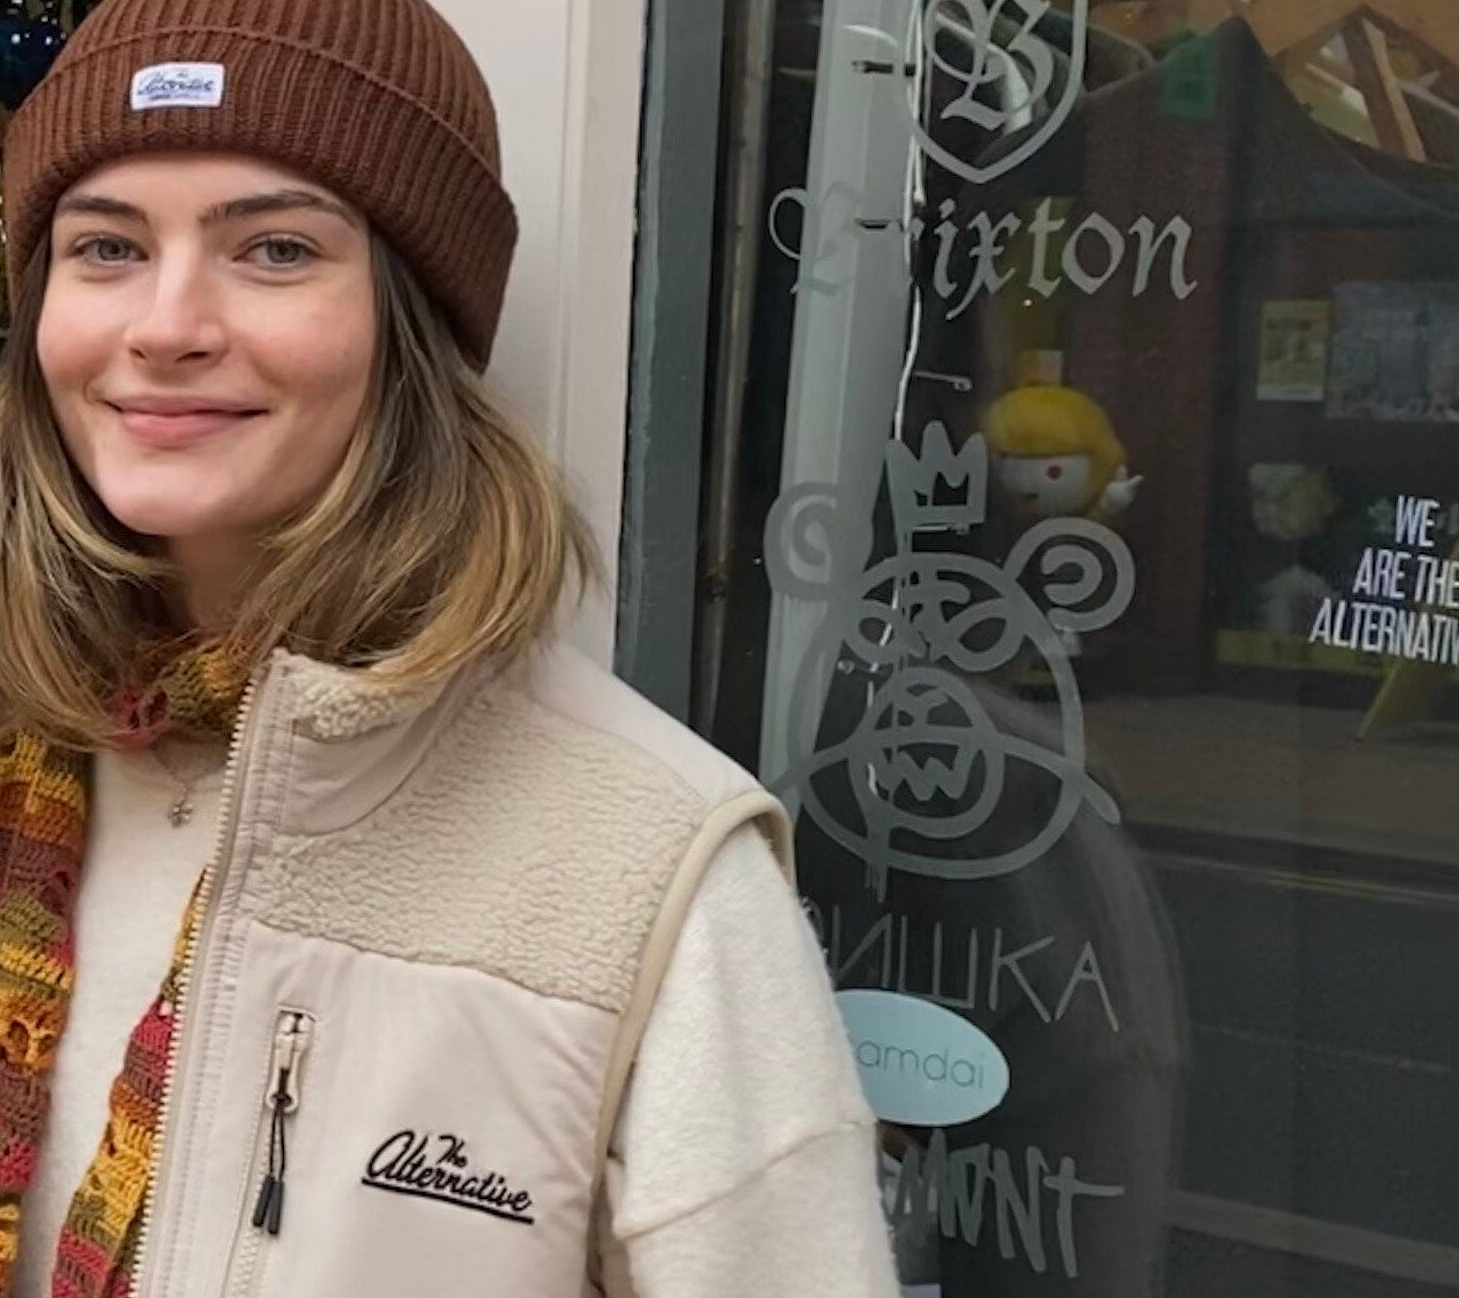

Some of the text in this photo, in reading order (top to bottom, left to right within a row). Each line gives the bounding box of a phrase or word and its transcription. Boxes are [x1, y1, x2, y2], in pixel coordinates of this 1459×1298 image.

[1395, 494, 1439, 548] WE
[1352, 547, 1459, 608] ARE THE
[1309, 597, 1459, 666] ALTERNATI
[856, 1038, 986, 1091] amdai
[365, 1130, 533, 1212] Alternative
[437, 1134, 468, 1168] The
